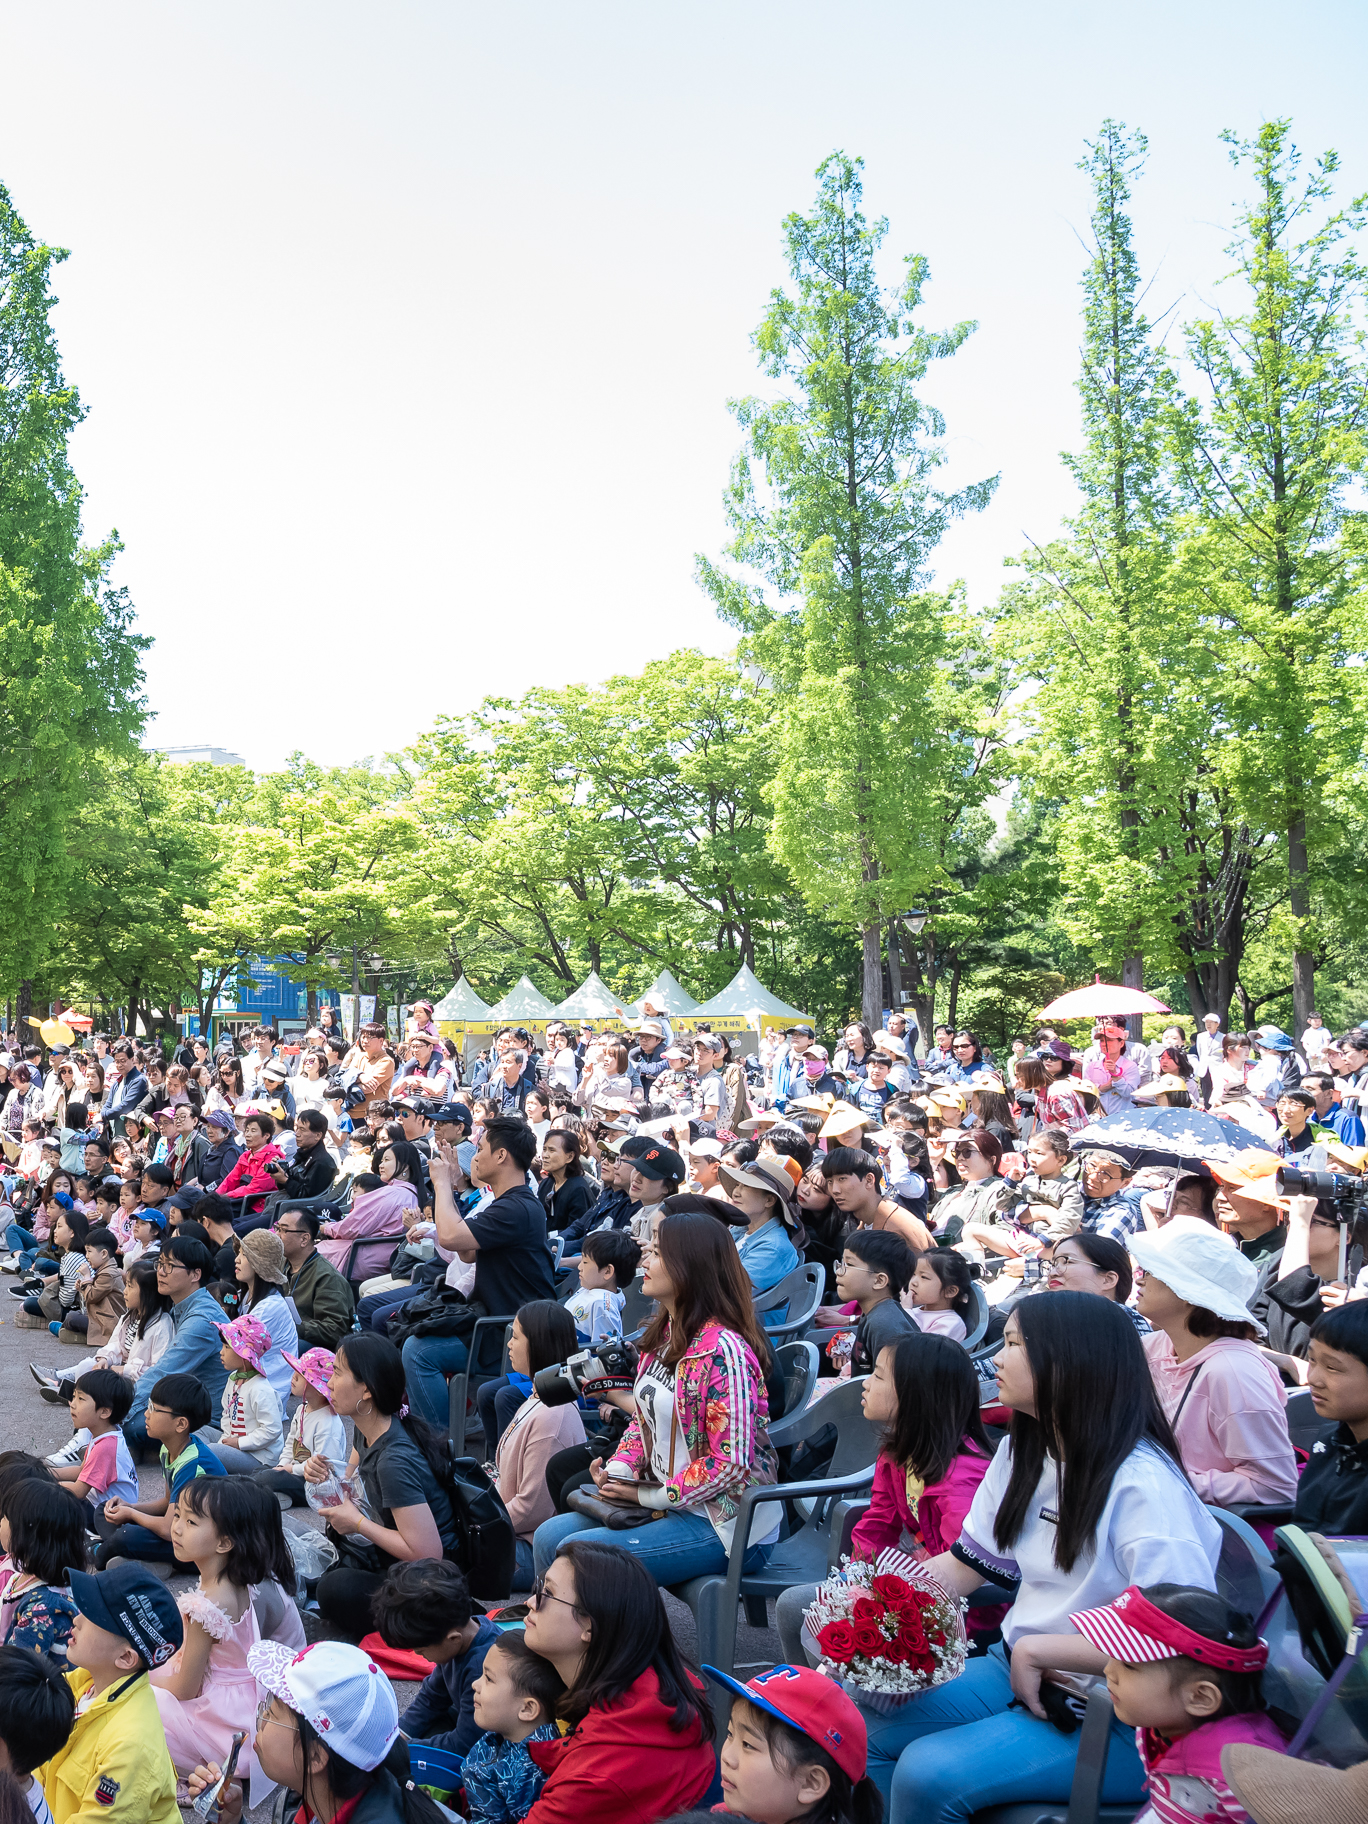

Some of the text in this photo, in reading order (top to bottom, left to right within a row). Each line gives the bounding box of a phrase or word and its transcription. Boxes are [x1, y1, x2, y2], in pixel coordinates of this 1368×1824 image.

[585, 1381, 602, 1393] OS
[603, 1380, 613, 1388] 5D
[126, 1594, 141, 1610] NEW
[137, 1594, 164, 1631] MANHATTAN
